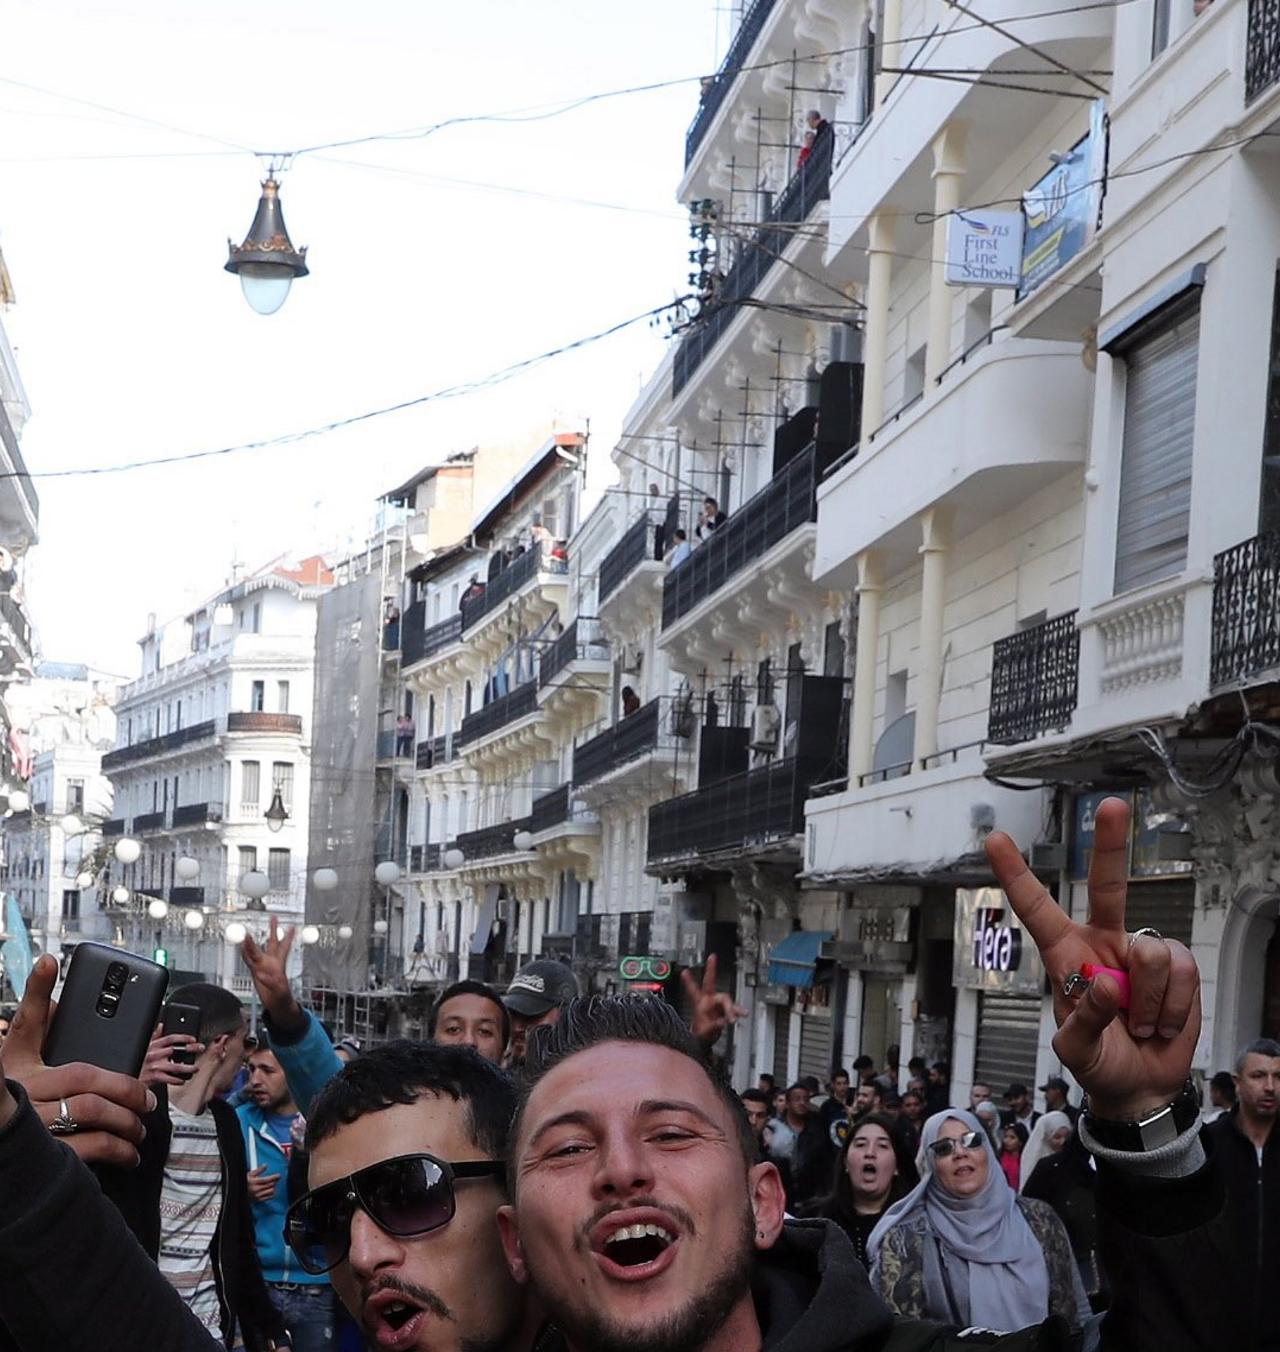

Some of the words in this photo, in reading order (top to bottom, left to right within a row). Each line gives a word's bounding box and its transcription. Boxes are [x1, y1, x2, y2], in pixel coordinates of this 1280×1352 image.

[964, 234, 998, 251] First
[964, 250, 998, 265] Line
[962, 264, 1014, 281] School
